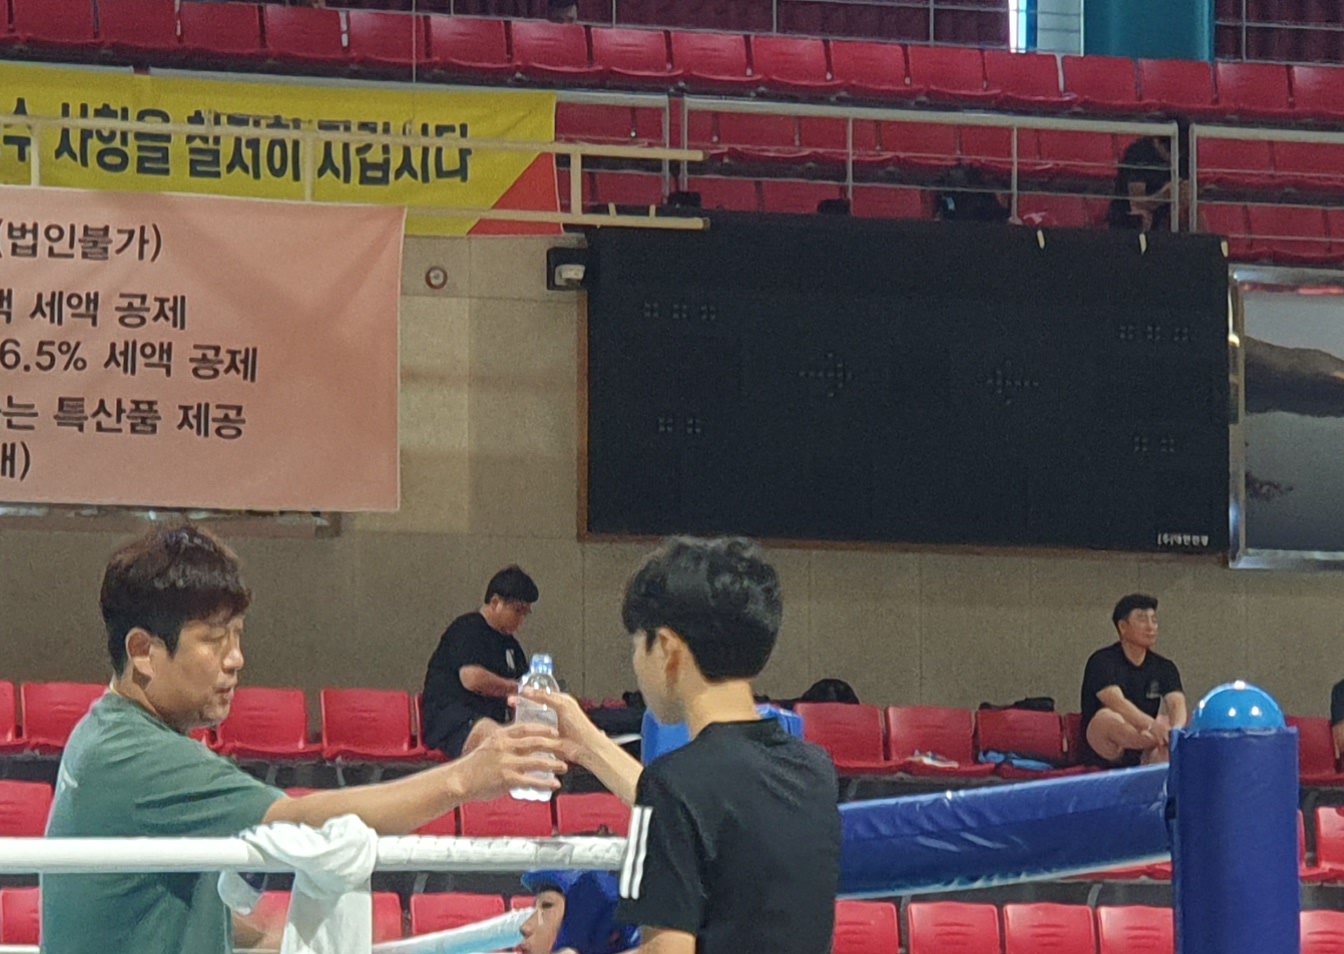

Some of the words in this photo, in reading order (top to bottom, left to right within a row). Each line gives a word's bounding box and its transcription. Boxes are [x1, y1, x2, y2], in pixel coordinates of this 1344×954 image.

[29, 289, 100, 328] 세액
[114, 292, 187, 331] 공제
[103, 339, 174, 378] 세액
[189, 344, 258, 383] 공제
[53, 396, 162, 435] 특산품
[176, 401, 247, 441] 제공
